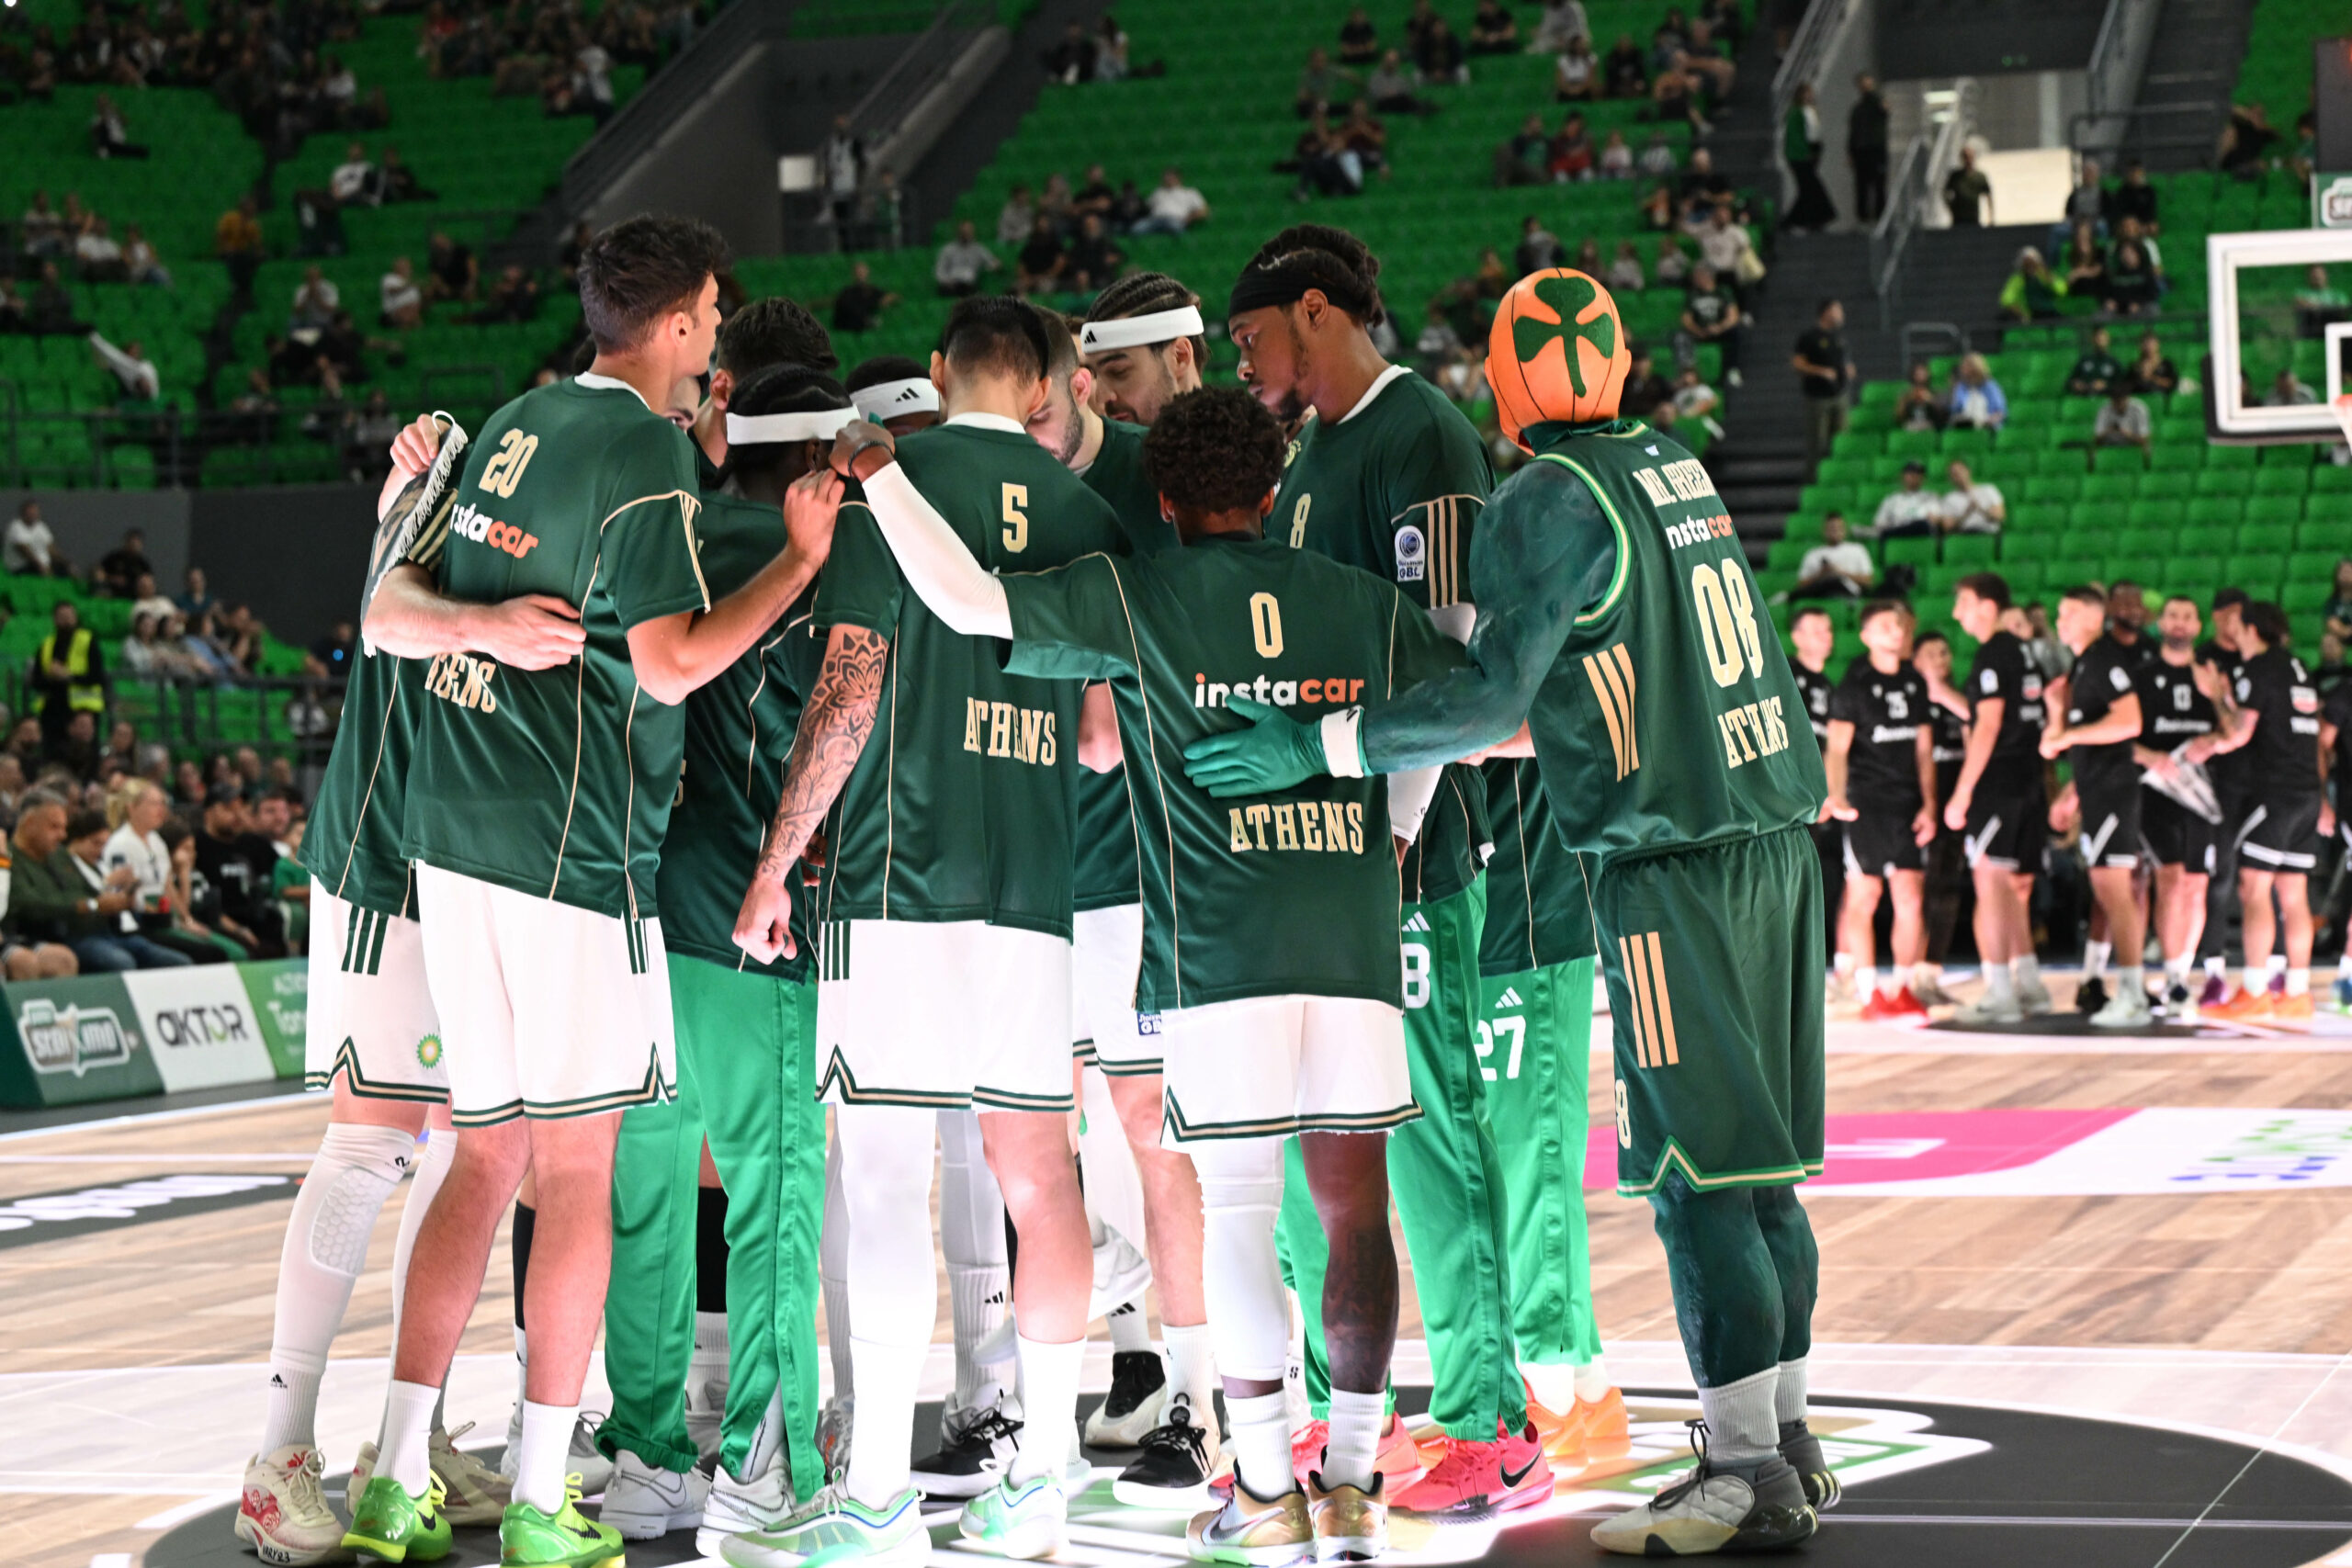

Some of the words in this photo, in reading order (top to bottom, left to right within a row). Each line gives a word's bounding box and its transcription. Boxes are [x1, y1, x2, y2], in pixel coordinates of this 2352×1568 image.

[479, 427, 539, 500] 20
[1001, 481, 1028, 554] 5
[1289, 492, 1312, 549] 8
[1665, 514, 1734, 550] nstacar
[1250, 592, 1284, 659] 0
[1691, 557, 1764, 688] 08
[1194, 672, 1365, 708] instacar
[1228, 800, 1364, 855] ATHENS
[1473, 1014, 1527, 1082] 27
